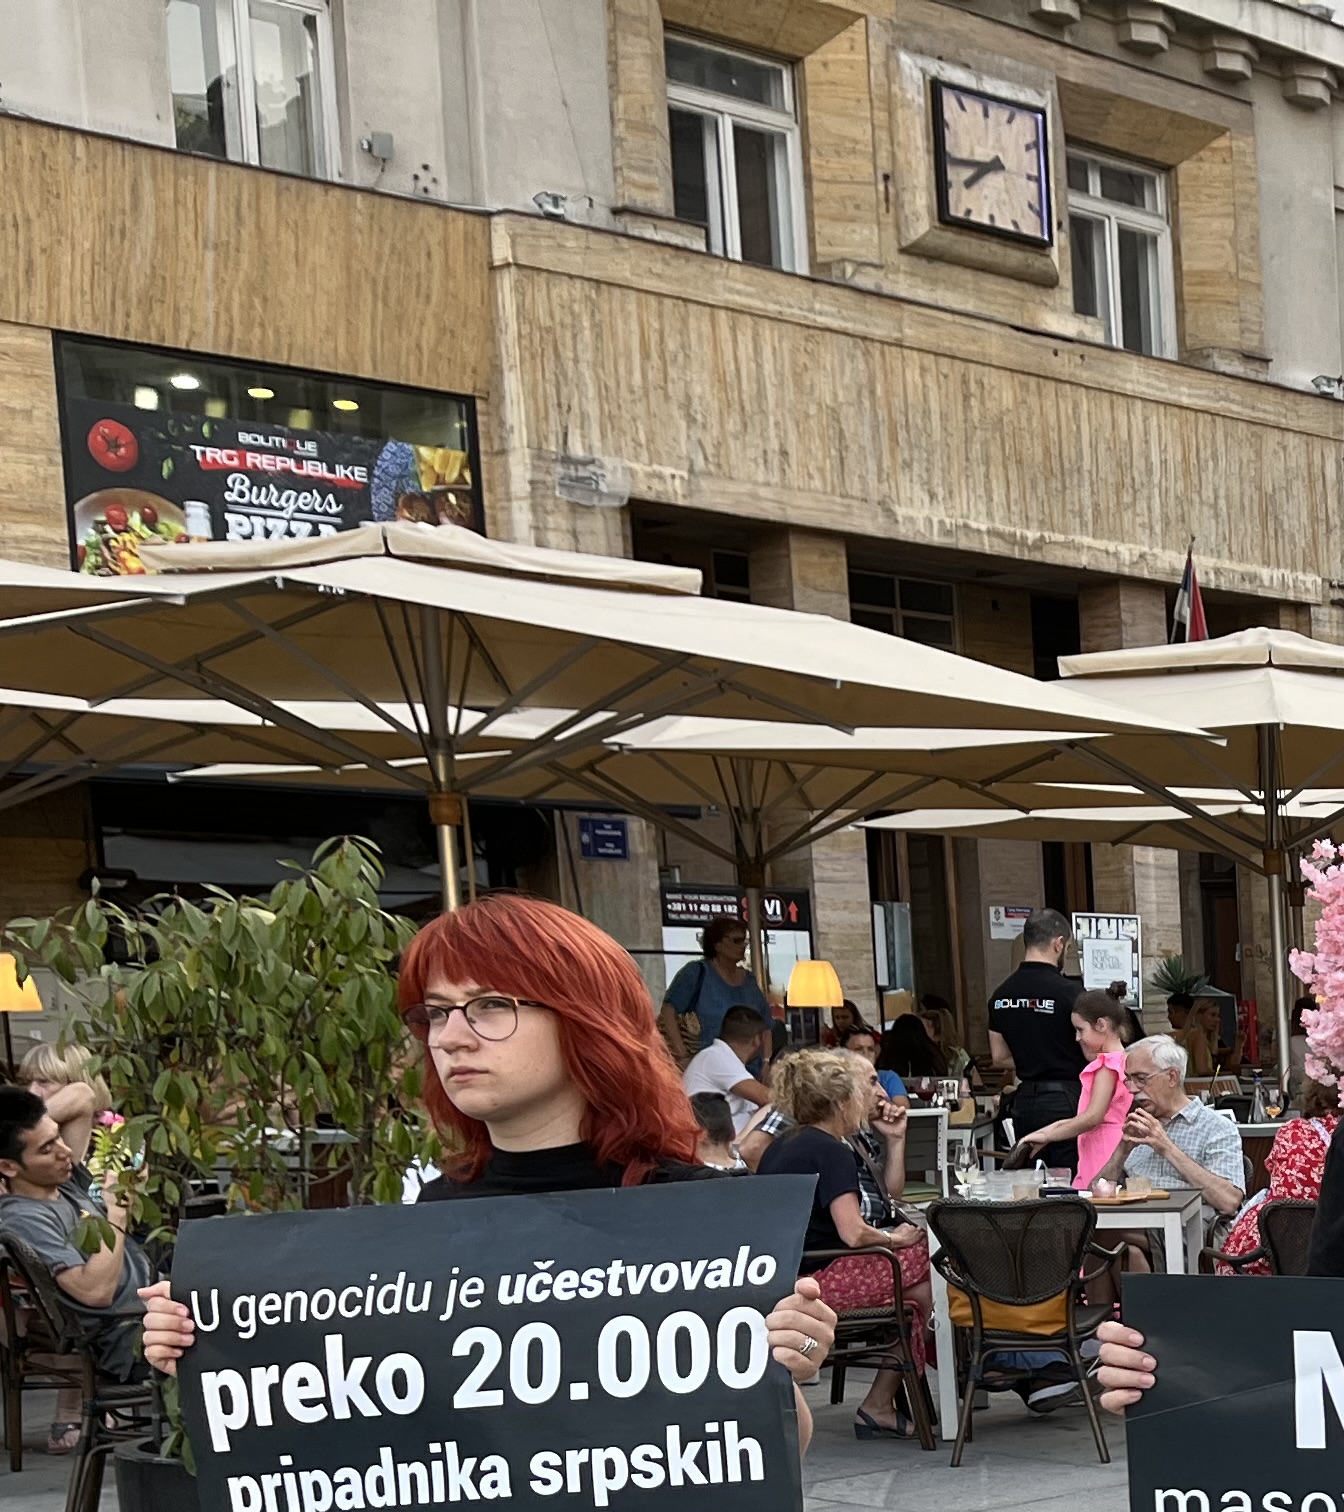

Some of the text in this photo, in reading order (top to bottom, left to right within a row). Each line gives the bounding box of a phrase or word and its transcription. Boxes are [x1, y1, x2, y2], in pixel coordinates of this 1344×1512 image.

[189, 444, 369, 483] TRG REPUBLIKE
[237, 431, 318, 451] BOUTIQUE
[224, 472, 344, 519] Burgers
[994, 998, 1055, 1009] BOUTIQUE
[190, 1245, 777, 1340] U genocidu je učestvovalo
[200, 1306, 770, 1453] preko 20.000
[529, 1420, 765, 1508] srpskih
